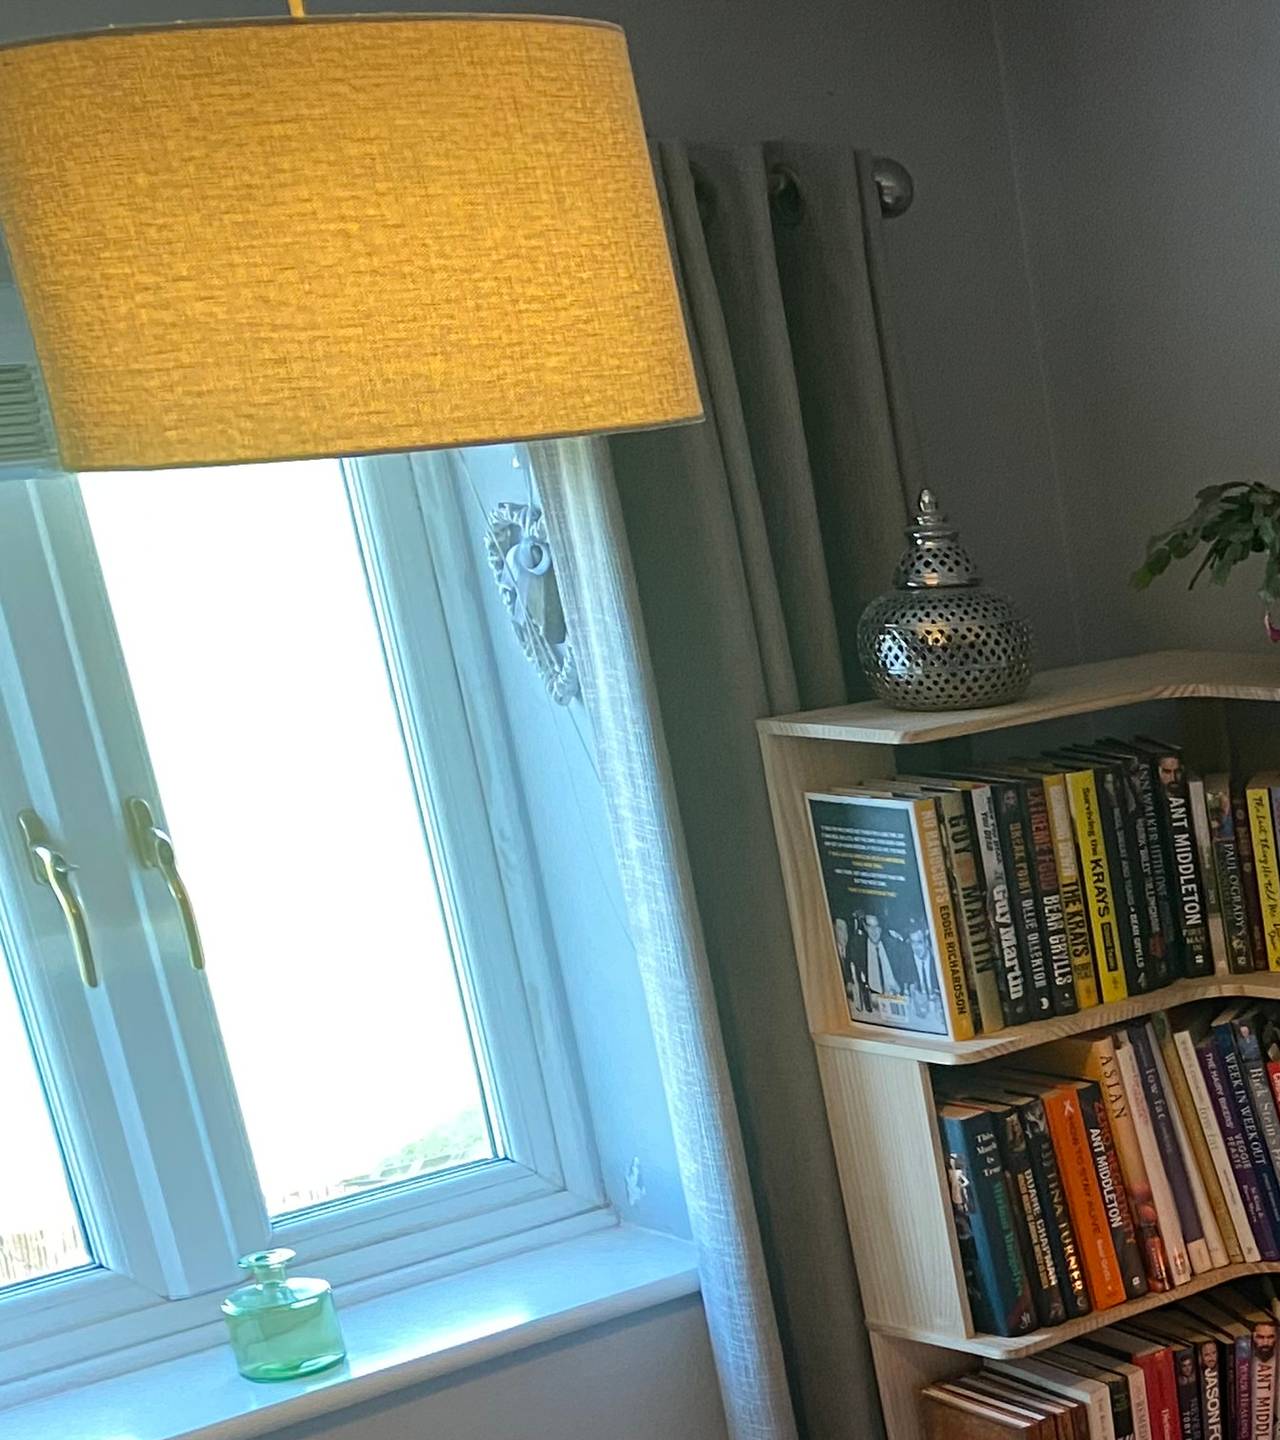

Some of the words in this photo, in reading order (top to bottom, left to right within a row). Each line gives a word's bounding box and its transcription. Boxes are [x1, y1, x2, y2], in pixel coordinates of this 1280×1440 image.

[1168, 797, 1188, 828] ANT
[1083, 787, 1096, 837] Surviving
[1090, 858, 1110, 918] KRAYS
[1224, 843, 1238, 878] PAUL
[949, 814, 971, 854] GUY
[961, 885, 994, 974] MARTIN
[1062, 880, 1081, 908] THE
[1173, 834, 1203, 925] MIDDLETON
[993, 884, 1012, 924] Guy
[1021, 899, 1038, 930] OLLIE
[1043, 894, 1065, 931] BEAR
[1067, 909, 1089, 958] KRAYS
[1133, 937, 1145, 969] GRYLLS
[939, 905, 953, 939] EDDIE
[946, 941, 968, 1015] RICHARDSON
[999, 924, 1023, 1000] Martin
[1027, 932, 1047, 989] OLLERTON
[1048, 934, 1072, 986] GRYLLS
[1205, 1052, 1214, 1069] THE
[1224, 1051, 1243, 1091] WEEK
[1100, 1055, 1128, 1121] ASIAN
[1146, 1068, 1160, 1097] low
[1236, 1090, 1247, 1103] IN
[1250, 1067, 1269, 1097] Rick
[1241, 1104, 1259, 1144] WEEK
[1234, 1132, 1252, 1169] VEGGIE
[1251, 1141, 1266, 1165] OUT
[1089, 1128, 1104, 1154] ANT
[1097, 1157, 1123, 1229] MIDDLETON
[1024, 1168, 1041, 1217] DUANE
[1036, 1220, 1058, 1287] CHAPMAN
[1047, 1173, 1065, 1216] TINA
[1058, 1221, 1085, 1294] TURNER
[1204, 1367, 1221, 1424] JASON
[1256, 1363, 1273, 1391] ANT
[1182, 1411, 1192, 1437] TOBY
